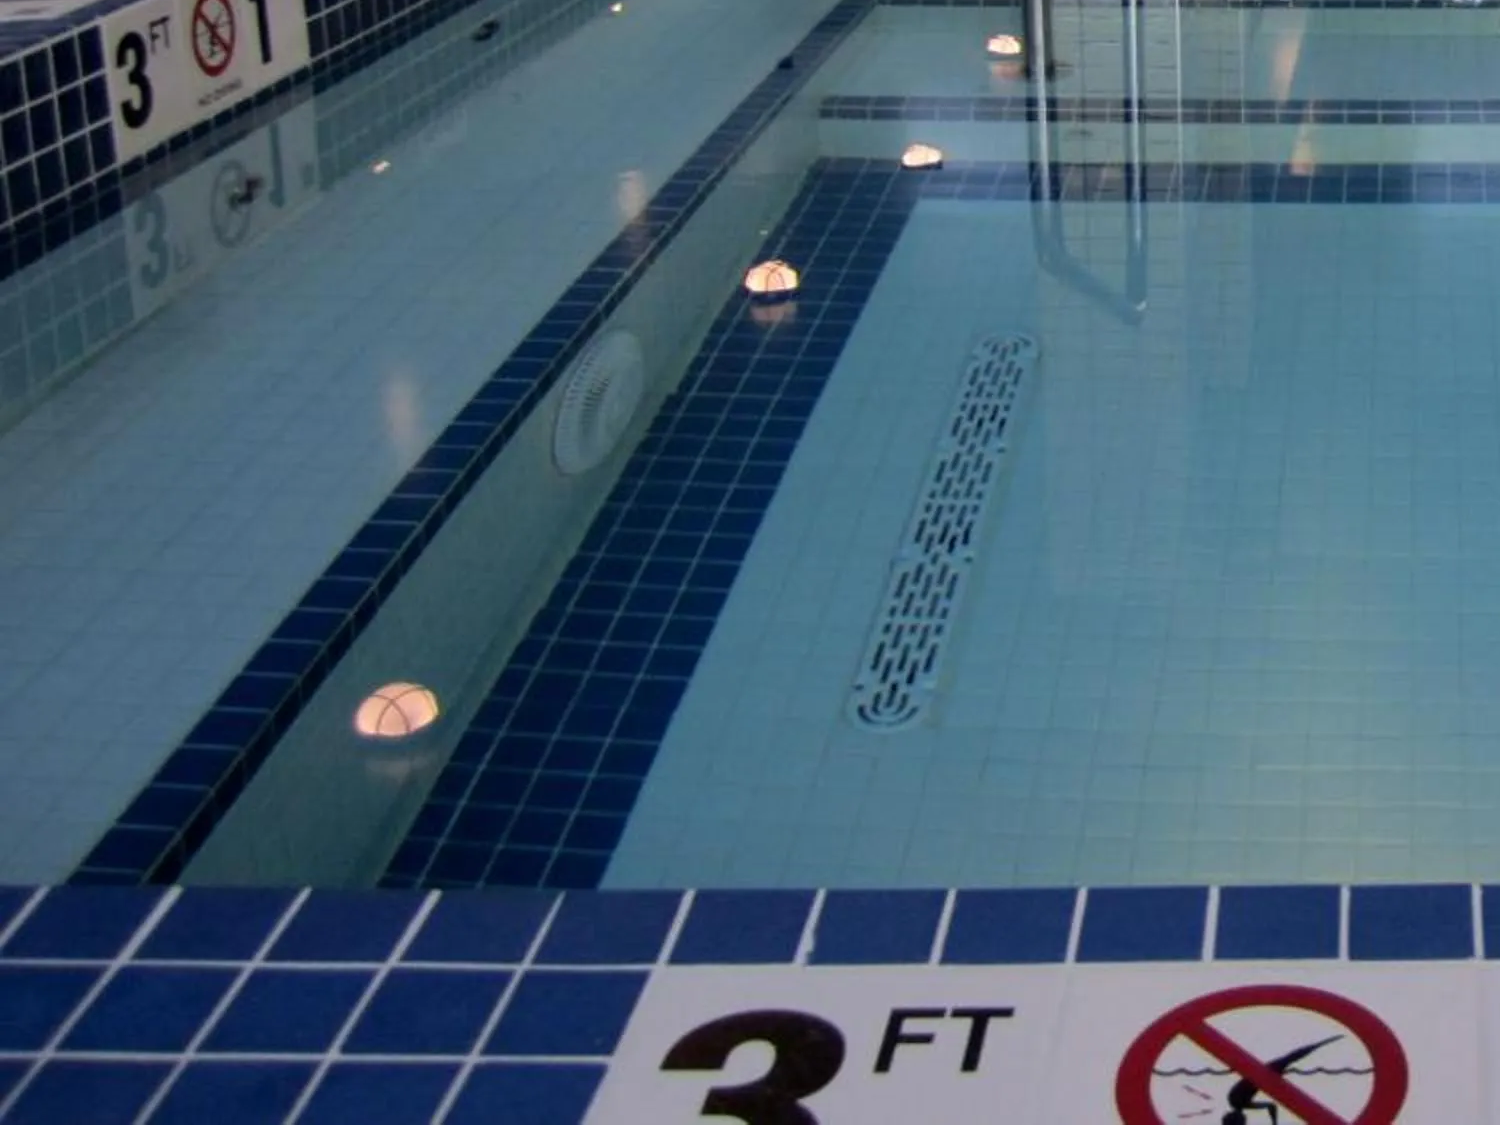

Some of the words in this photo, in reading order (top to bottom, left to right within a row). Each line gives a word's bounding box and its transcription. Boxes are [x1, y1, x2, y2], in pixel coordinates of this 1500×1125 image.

[116, 31, 153, 129] 3
[149, 15, 170, 54] FT
[659, 1008, 847, 1125] 3
[873, 1007, 1015, 1073] FT
